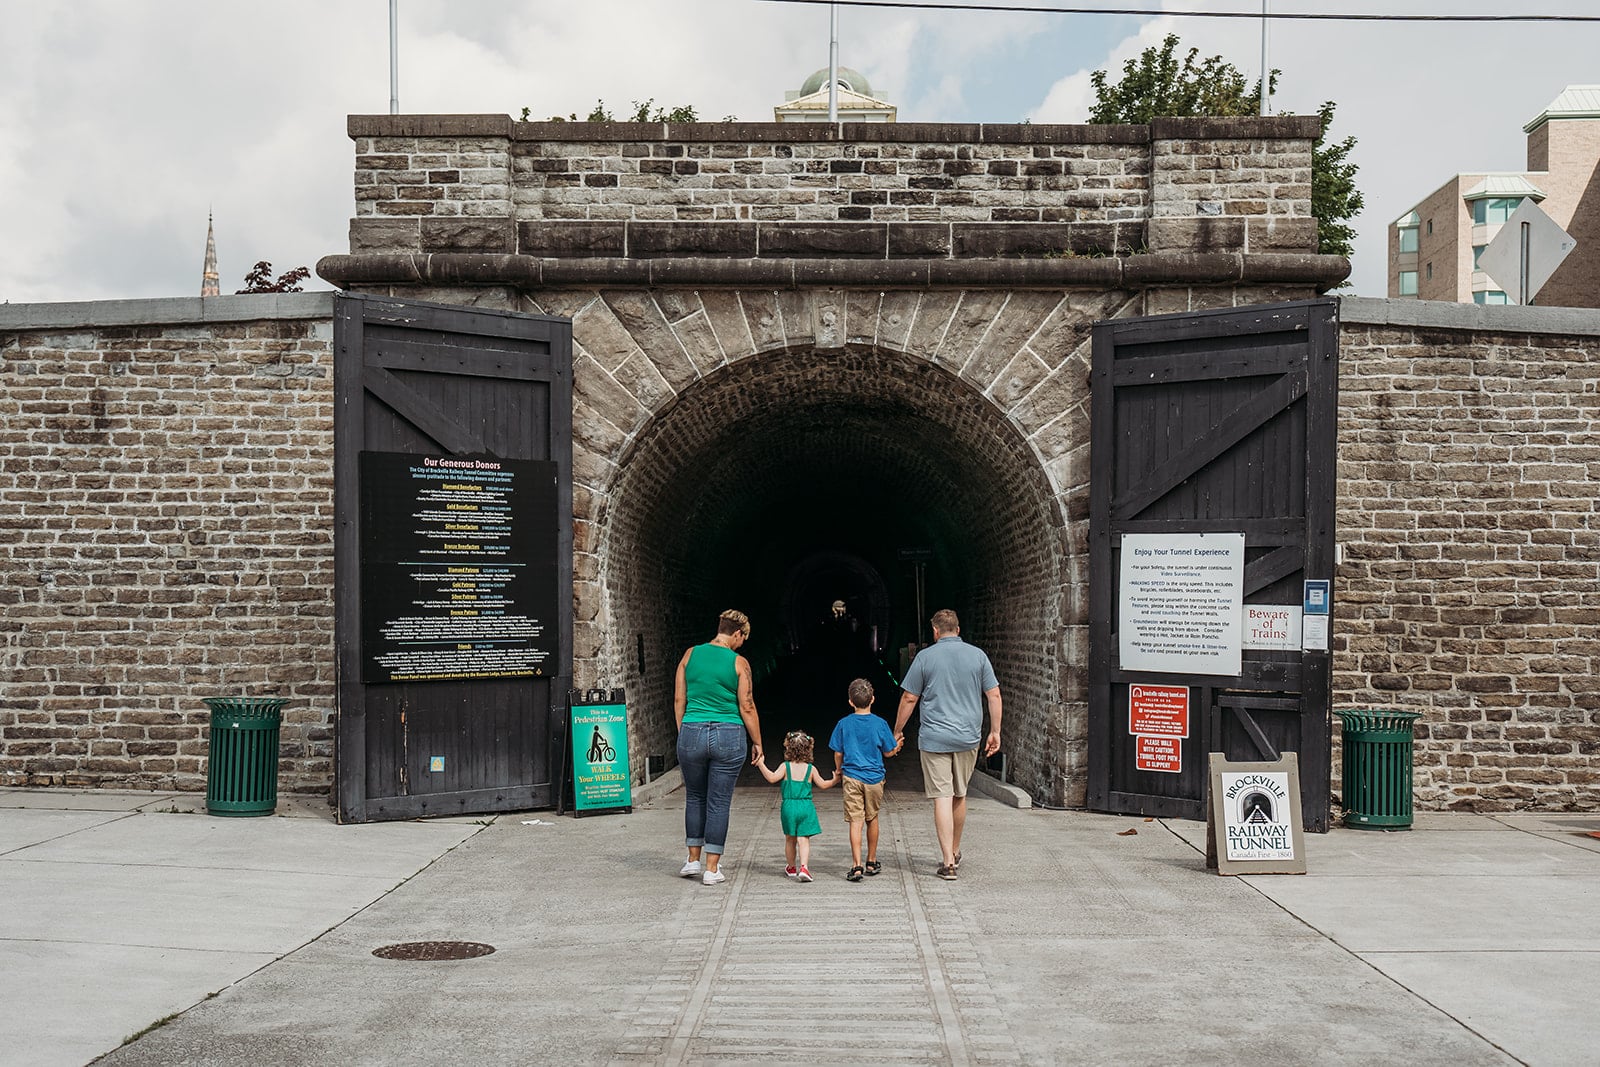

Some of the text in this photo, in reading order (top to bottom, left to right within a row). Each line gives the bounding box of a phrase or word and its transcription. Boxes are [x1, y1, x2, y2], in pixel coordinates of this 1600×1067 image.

[424, 458, 500, 470] Our Generous Donors
[1249, 610, 1289, 619] Beware
[1263, 620, 1273, 628] of
[1251, 629, 1286, 639] Trains
[574, 716, 607, 724] Pedestrian
[595, 774, 625, 782] WHEELS
[1226, 776, 1286, 799] BROCKVILLE
[1228, 825, 1288, 837] RAILWAY
[1229, 837, 1291, 850] TUNNEL
